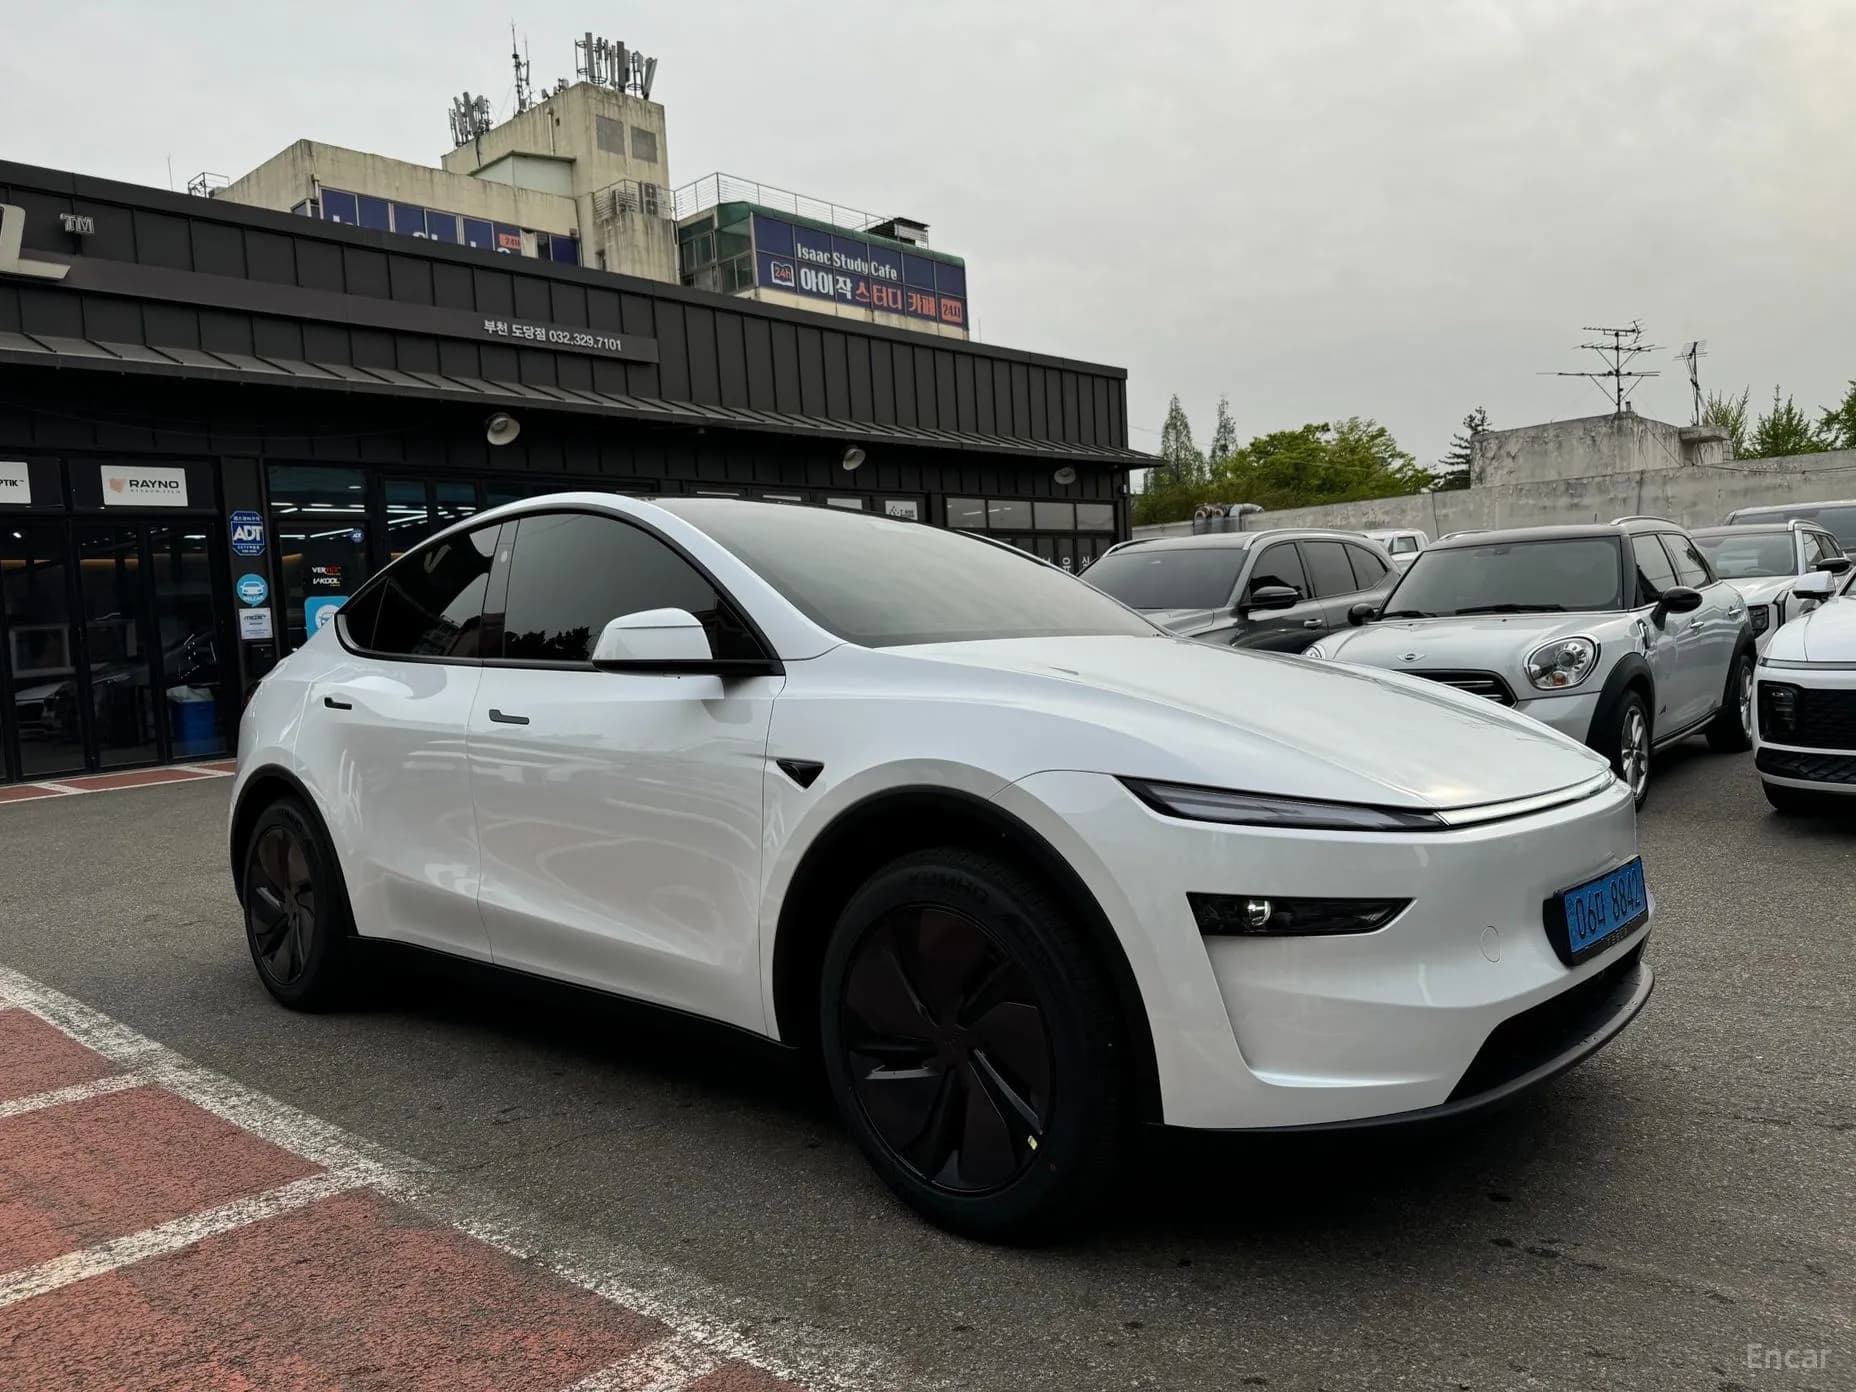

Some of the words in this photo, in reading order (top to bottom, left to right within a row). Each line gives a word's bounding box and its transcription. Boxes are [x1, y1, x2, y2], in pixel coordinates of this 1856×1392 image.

[797, 243, 831, 265] Isaac
[832, 252, 869, 275] Study
[870, 261, 898, 281] Cafe
[800, 268, 853, 300] 아이작
[856, 281, 902, 310] 스터디
[908, 292, 936, 317] 카페
[483, 319, 508, 336] 부천
[512, 324, 546, 341] 도당점
[549, 330, 622, 351] 032.329.7101
[129, 479, 179, 489] RAYNO
[233, 525, 263, 541] ADT
